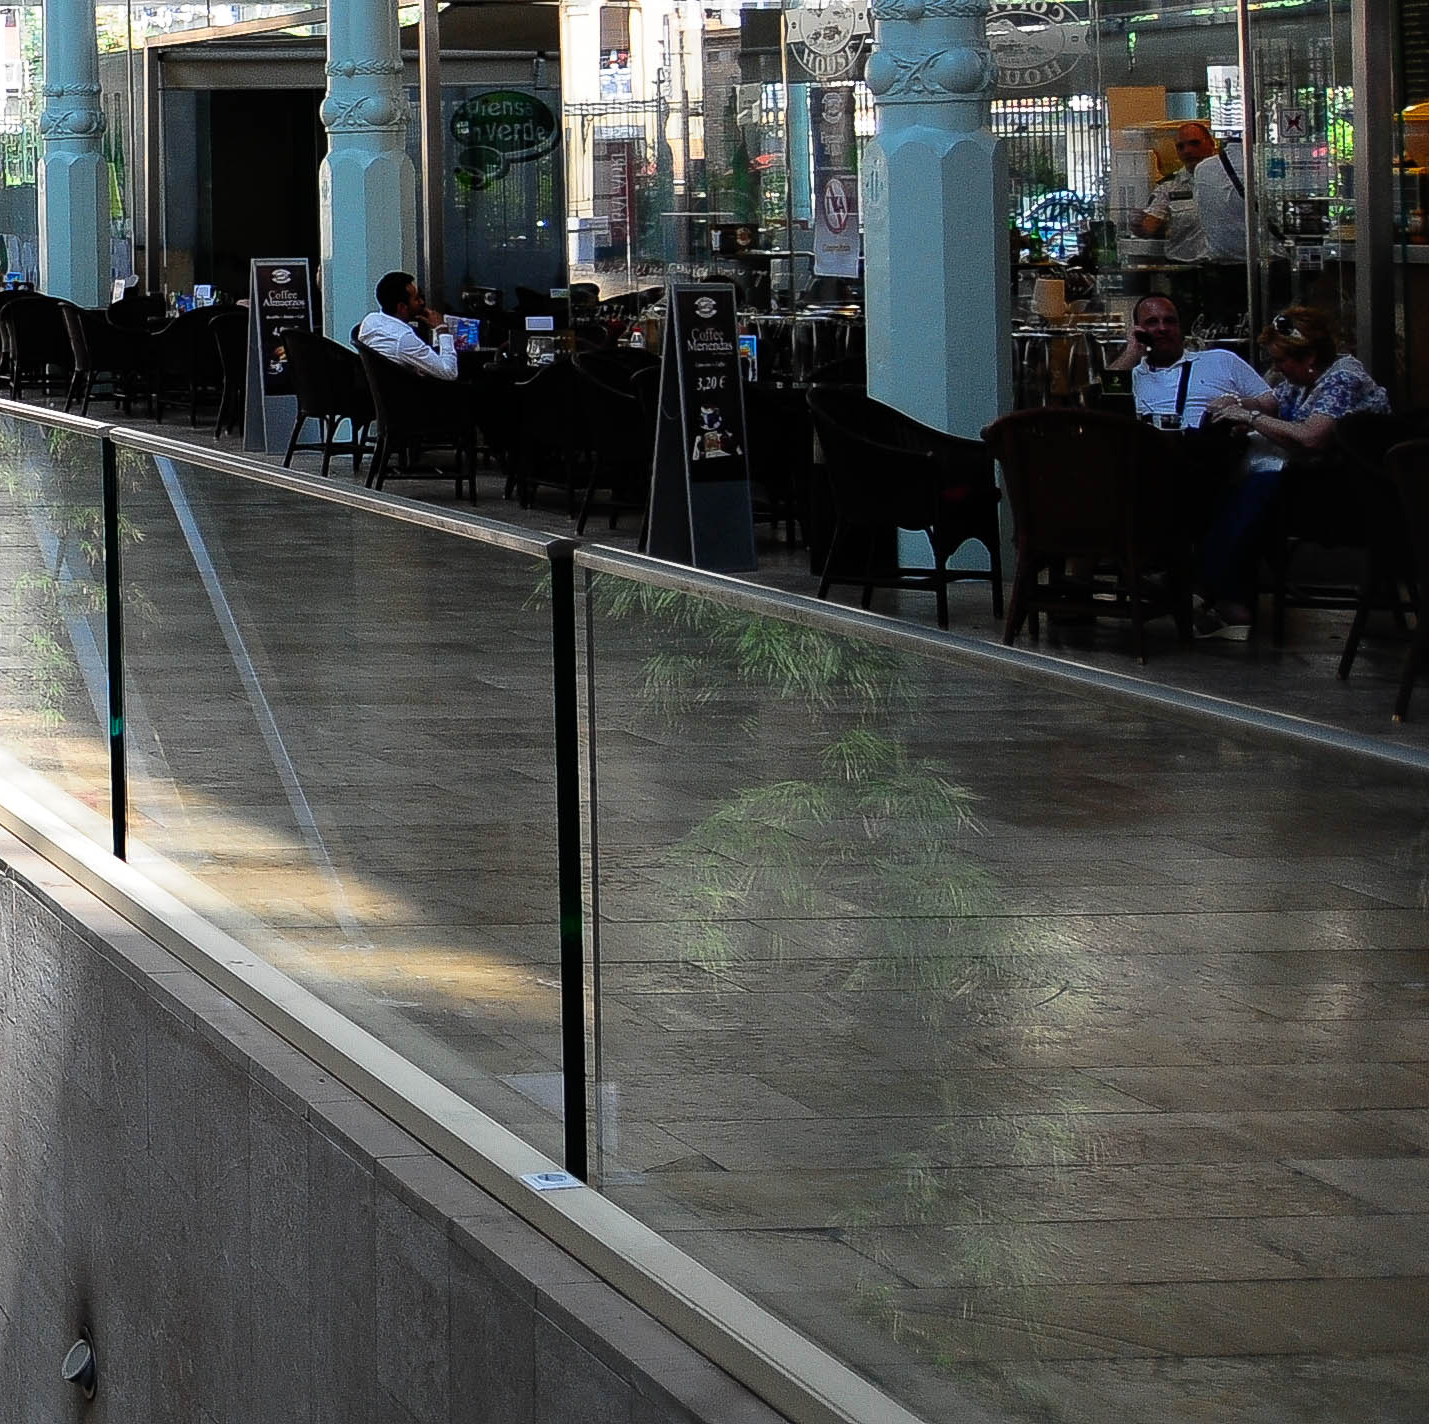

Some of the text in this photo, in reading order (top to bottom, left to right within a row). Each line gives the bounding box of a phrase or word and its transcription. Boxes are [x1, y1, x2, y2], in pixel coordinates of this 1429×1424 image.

[485, 119, 547, 142] verde
[691, 328, 724, 341] Coffee
[697, 376, 717, 391] 3,20
